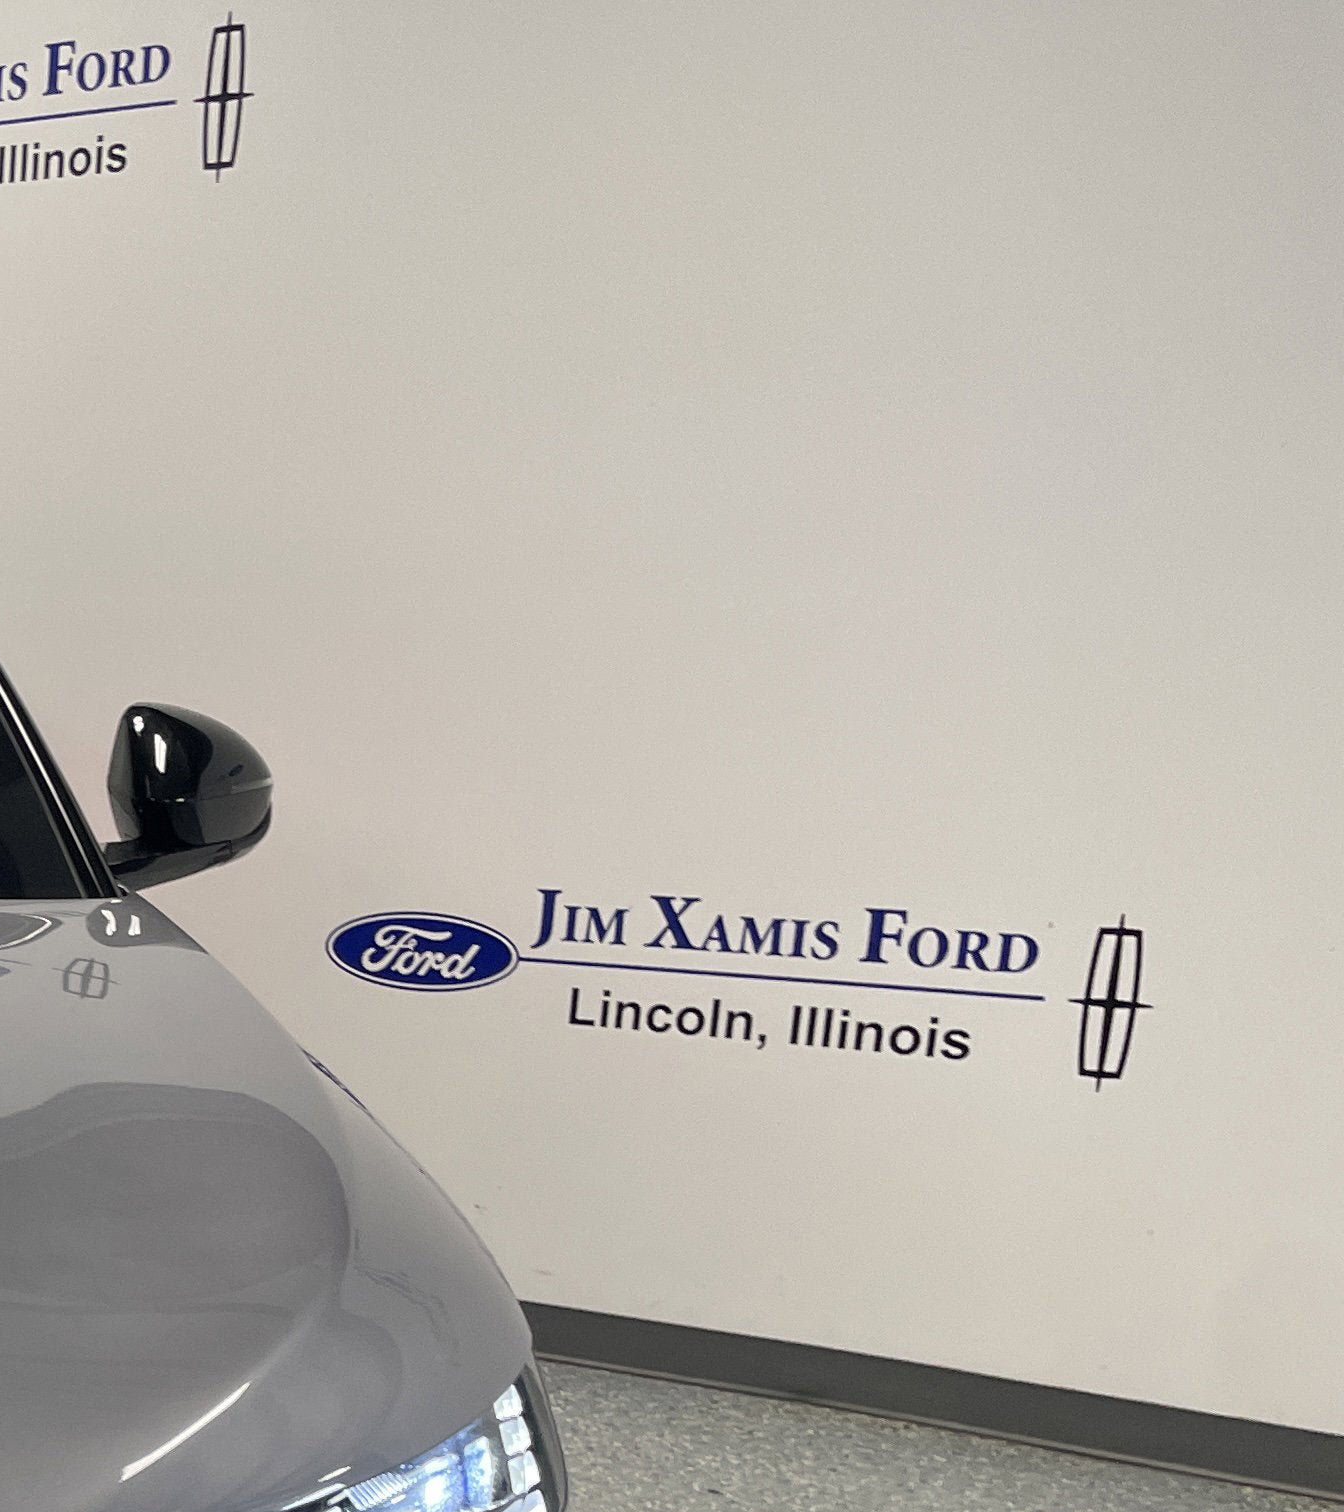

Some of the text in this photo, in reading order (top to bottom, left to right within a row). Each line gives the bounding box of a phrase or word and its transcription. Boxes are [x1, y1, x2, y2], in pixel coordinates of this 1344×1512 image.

[360, 922, 477, 982] Ford
[568, 987, 974, 1061] Lincoln, Illinois
